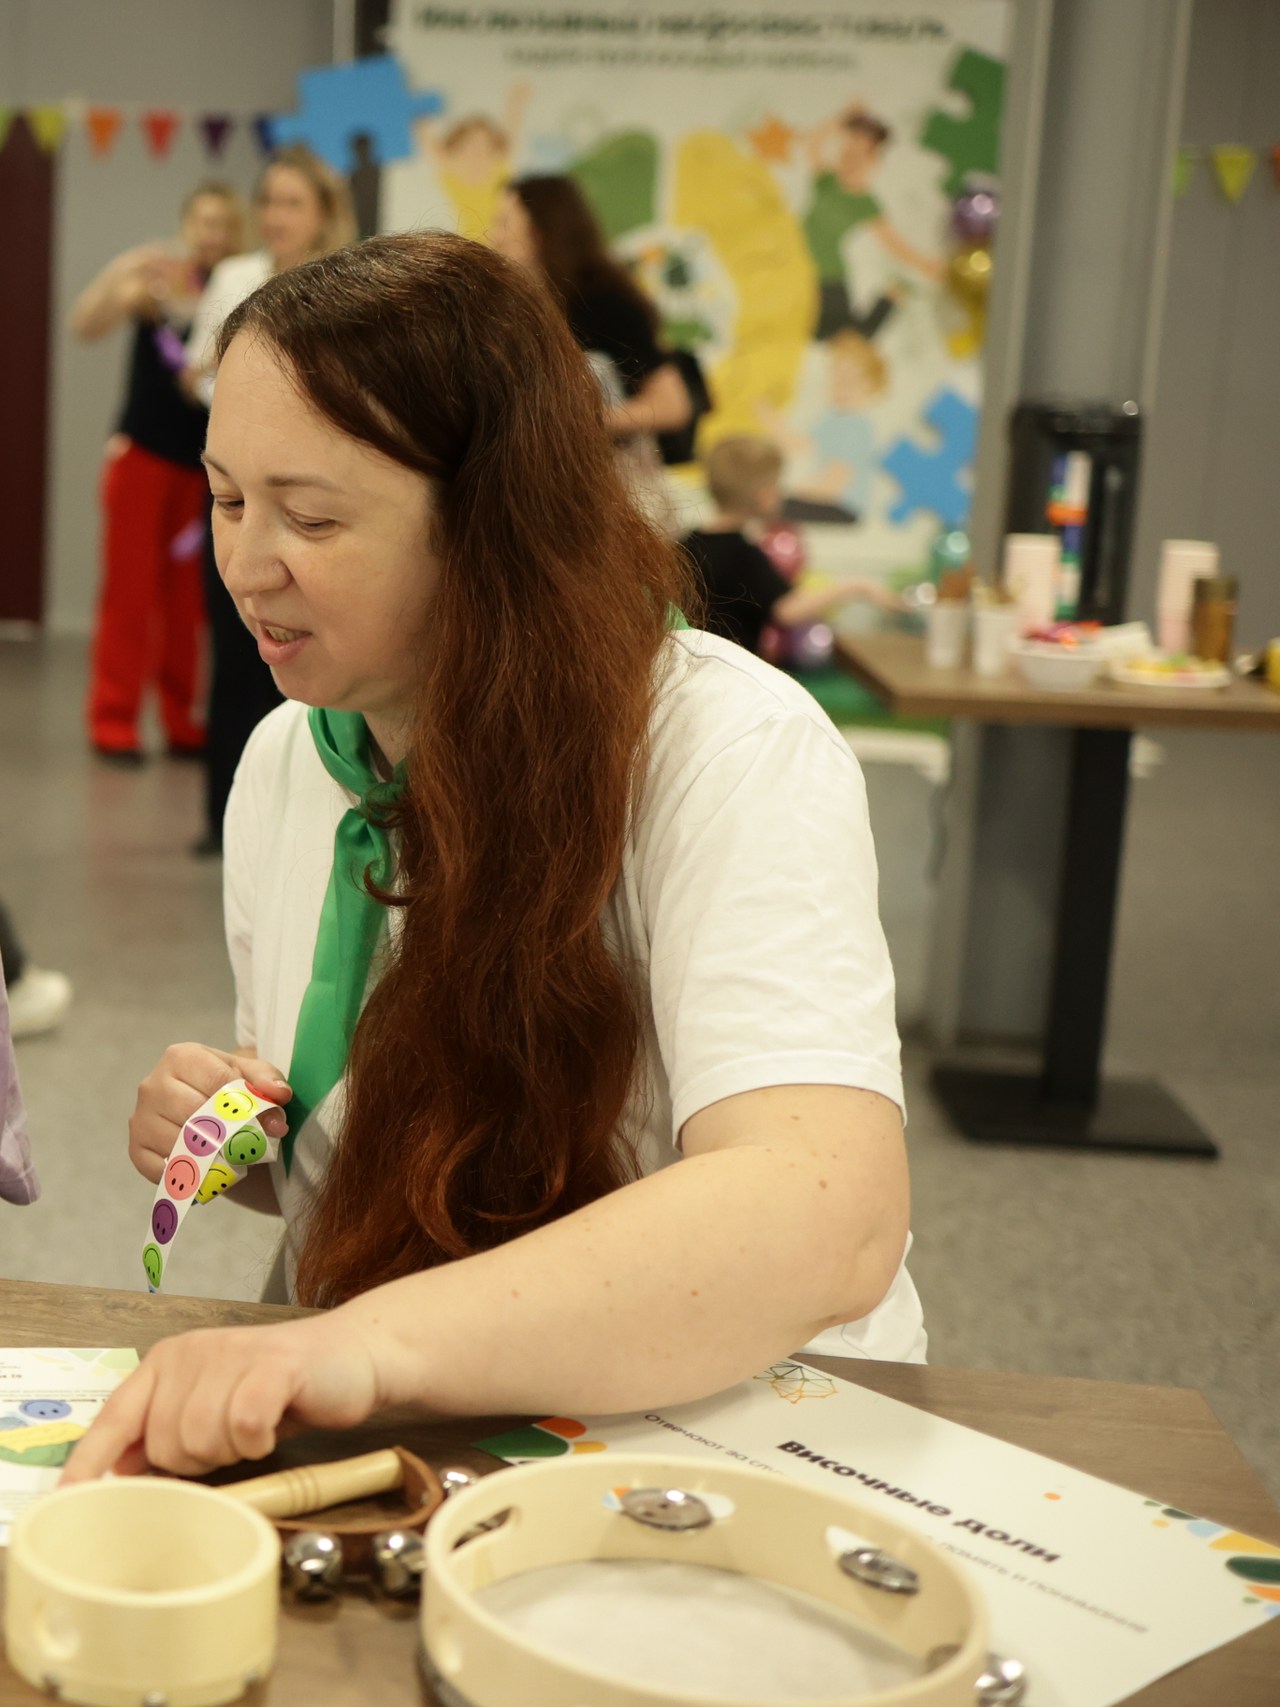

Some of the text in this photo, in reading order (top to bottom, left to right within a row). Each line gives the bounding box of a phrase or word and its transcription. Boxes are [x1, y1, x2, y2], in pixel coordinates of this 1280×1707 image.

[645, 1414, 725, 1451] Отвечают
[725, 1450, 748, 1461] за
[776, 1440, 1061, 1562] Височные доли
